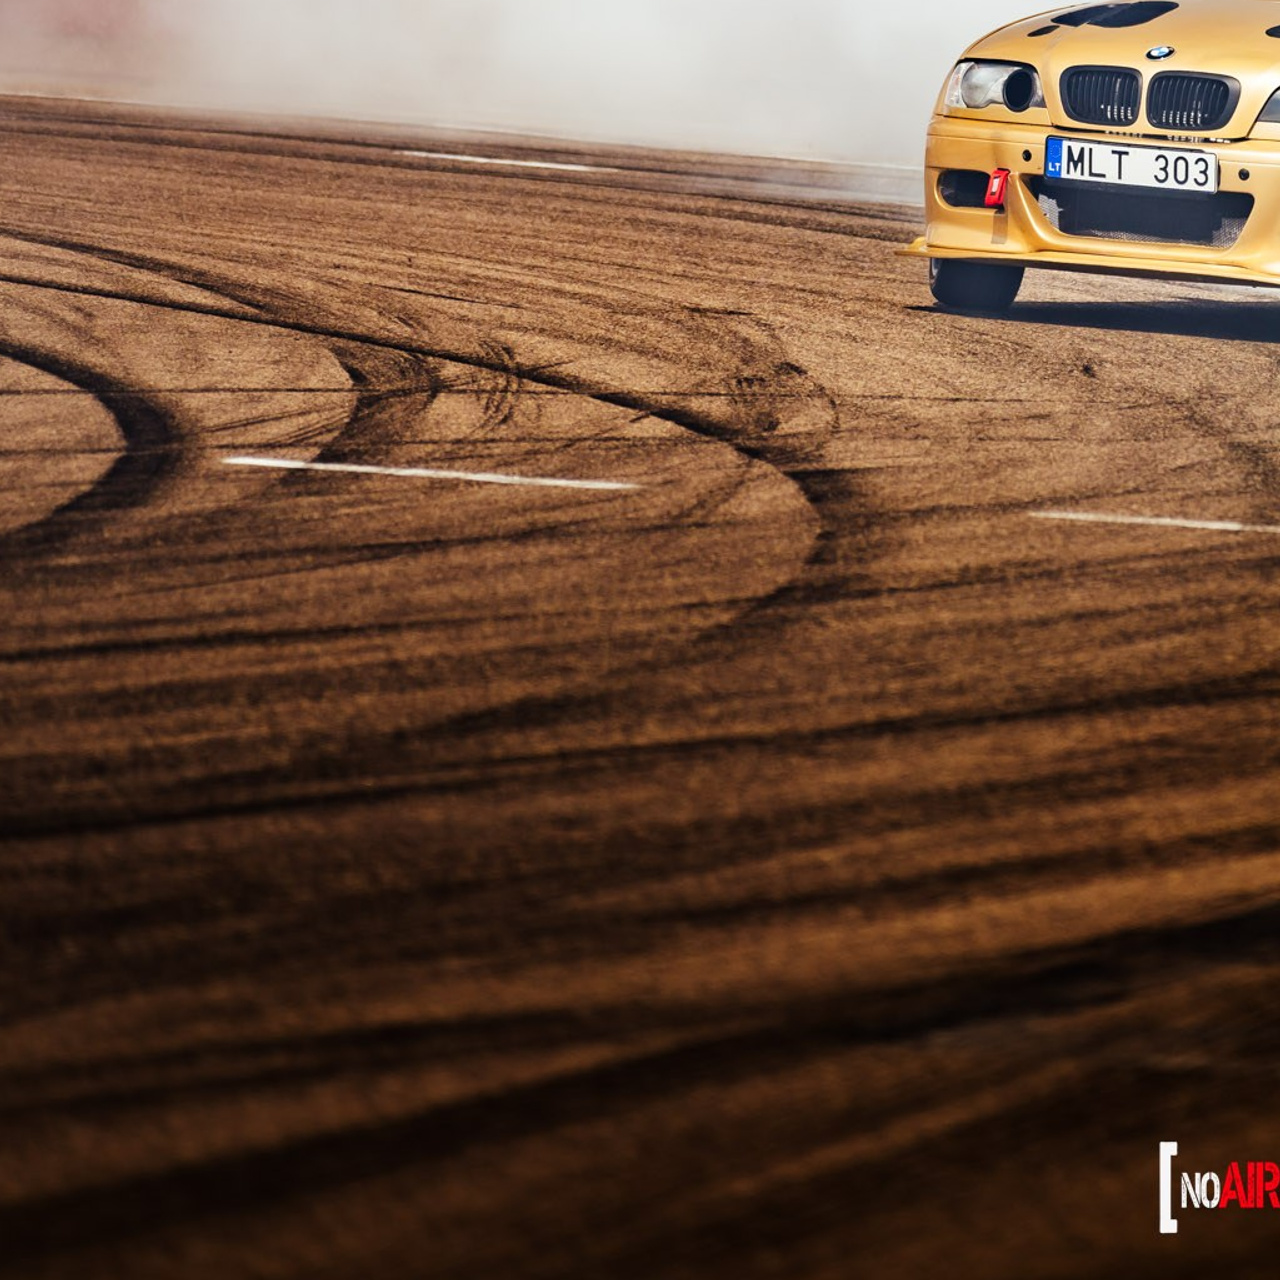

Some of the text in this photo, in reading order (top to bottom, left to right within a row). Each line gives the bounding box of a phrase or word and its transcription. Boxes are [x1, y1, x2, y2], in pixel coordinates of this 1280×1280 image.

[1049, 145, 1209, 187] LT MLT 303
